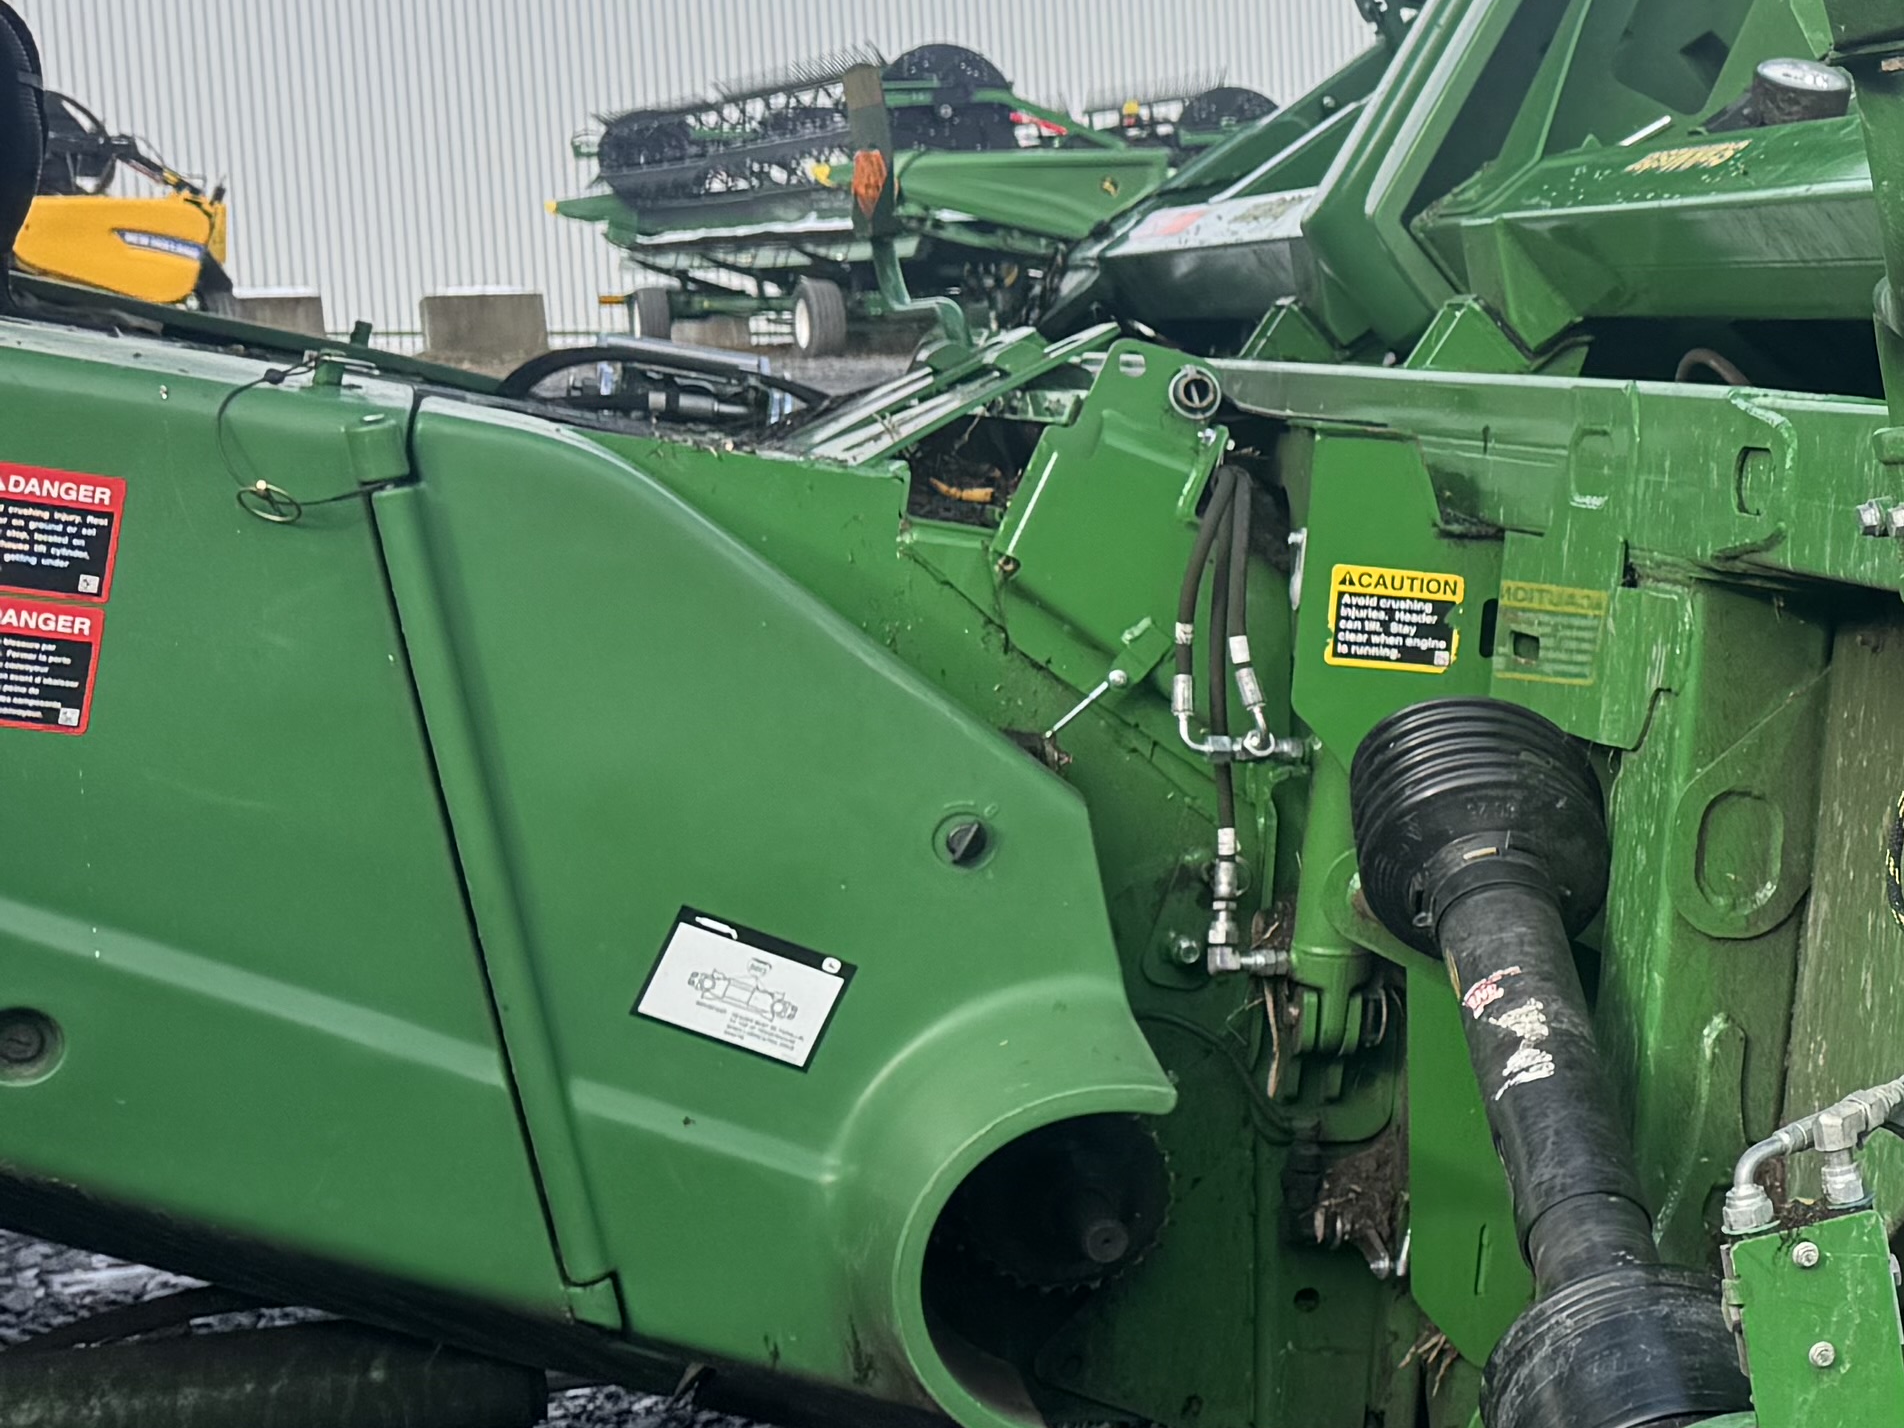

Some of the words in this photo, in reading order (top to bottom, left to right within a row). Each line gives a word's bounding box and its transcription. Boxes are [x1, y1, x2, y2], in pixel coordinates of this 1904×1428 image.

[8, 474, 112, 506] DANGER
[1358, 571, 1458, 597] CAUTION
[1341, 593, 1378, 607] Avoid
[1379, 598, 1433, 613] crushing
[1338, 619, 1361, 630] can
[1390, 622, 1417, 636] Stay
[1395, 610, 1438, 625] Header
[1337, 631, 1368, 643] clear
[1371, 634, 1403, 646] when
[1405, 637, 1447, 651] engine
[1337, 642, 1348, 654] is
[1351, 645, 1401, 660] running.
